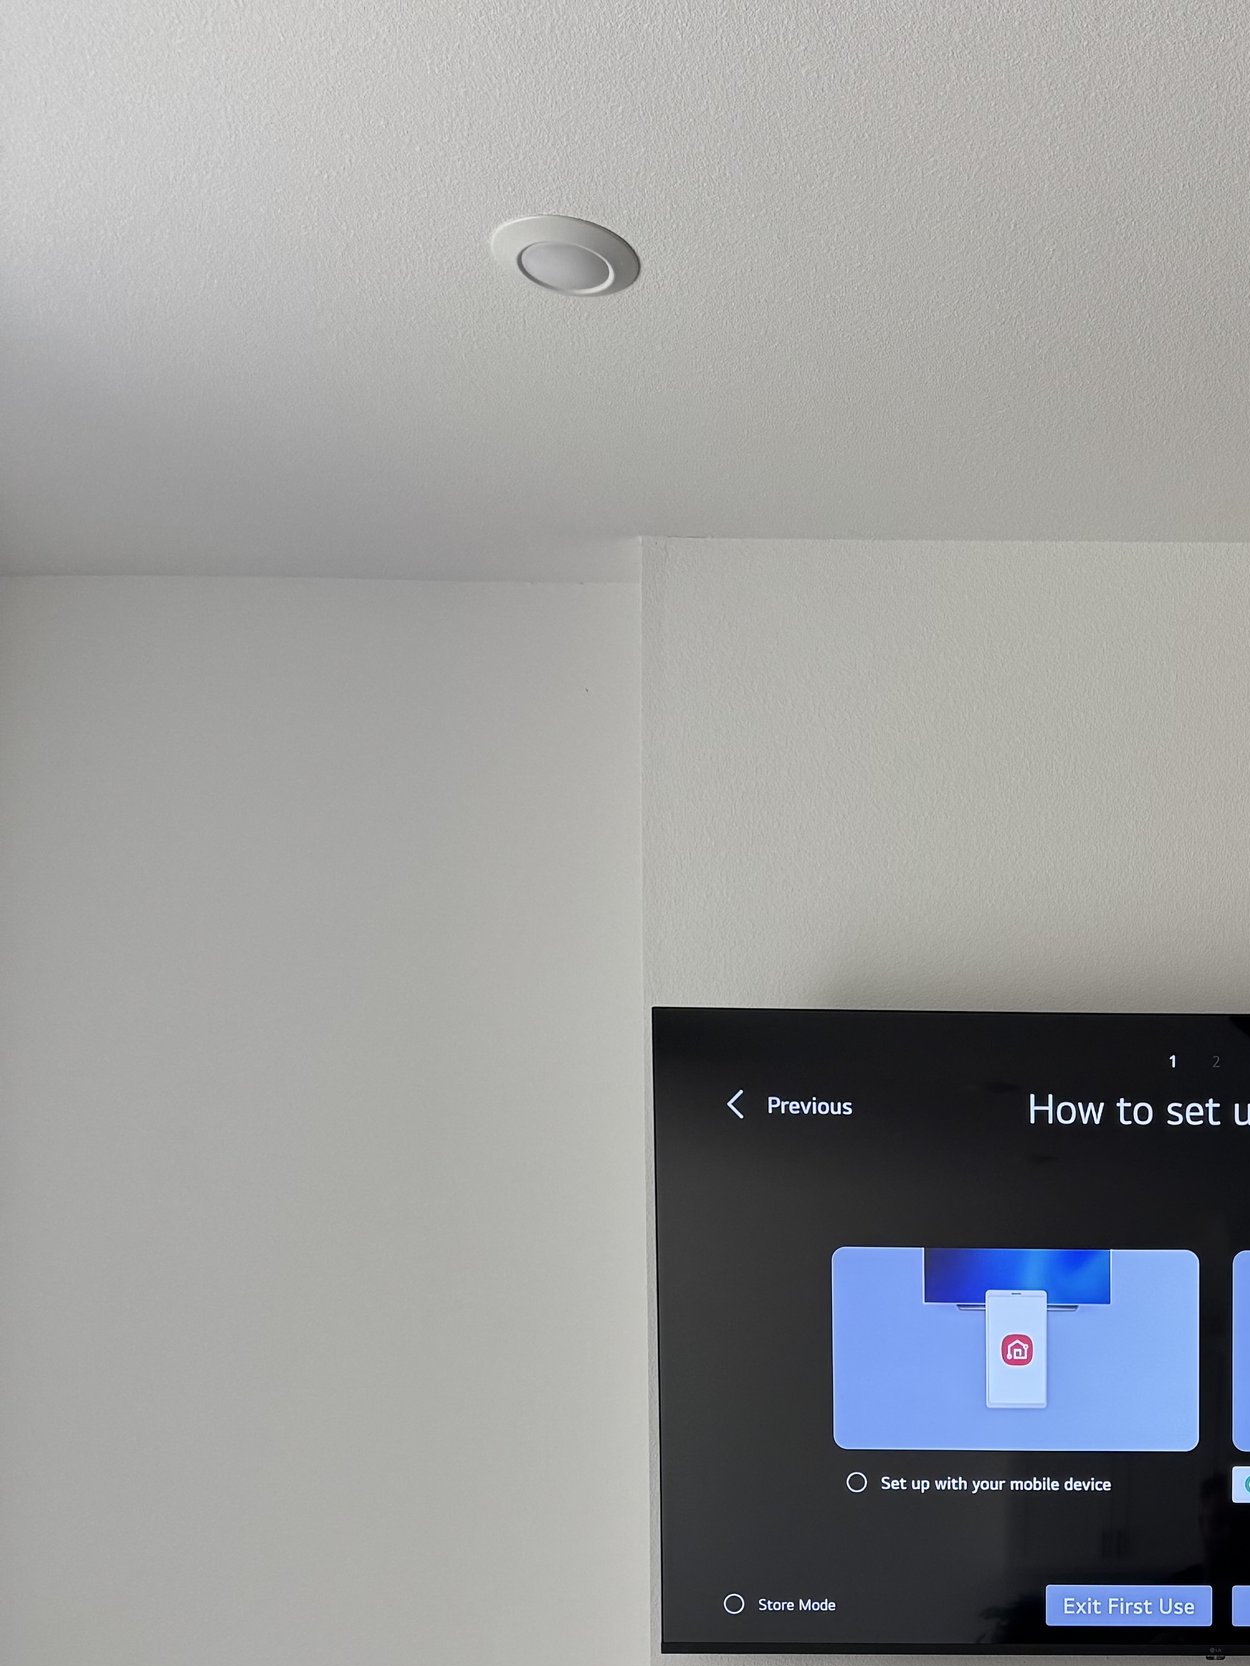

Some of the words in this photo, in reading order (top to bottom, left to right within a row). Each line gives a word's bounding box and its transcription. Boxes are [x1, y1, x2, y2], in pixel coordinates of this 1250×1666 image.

[1168, 1054, 1177, 1069] 1
[1212, 1055, 1221, 1068] 2
[767, 1096, 853, 1116] Previous
[1029, 1093, 1105, 1126] How
[1115, 1097, 1154, 1126] to
[1166, 1097, 1221, 1126] set
[880, 1476, 908, 1491] Set
[911, 1479, 931, 1495] up
[934, 1476, 968, 1491] with
[971, 1479, 1007, 1495] your
[1009, 1476, 1060, 1492] mobile
[1063, 1476, 1112, 1492] device
[758, 1598, 795, 1611] Store
[798, 1598, 836, 1612] Mode
[1064, 1597, 1102, 1615] Exit
[1108, 1597, 1153, 1615] First
[1159, 1598, 1195, 1615] Use
